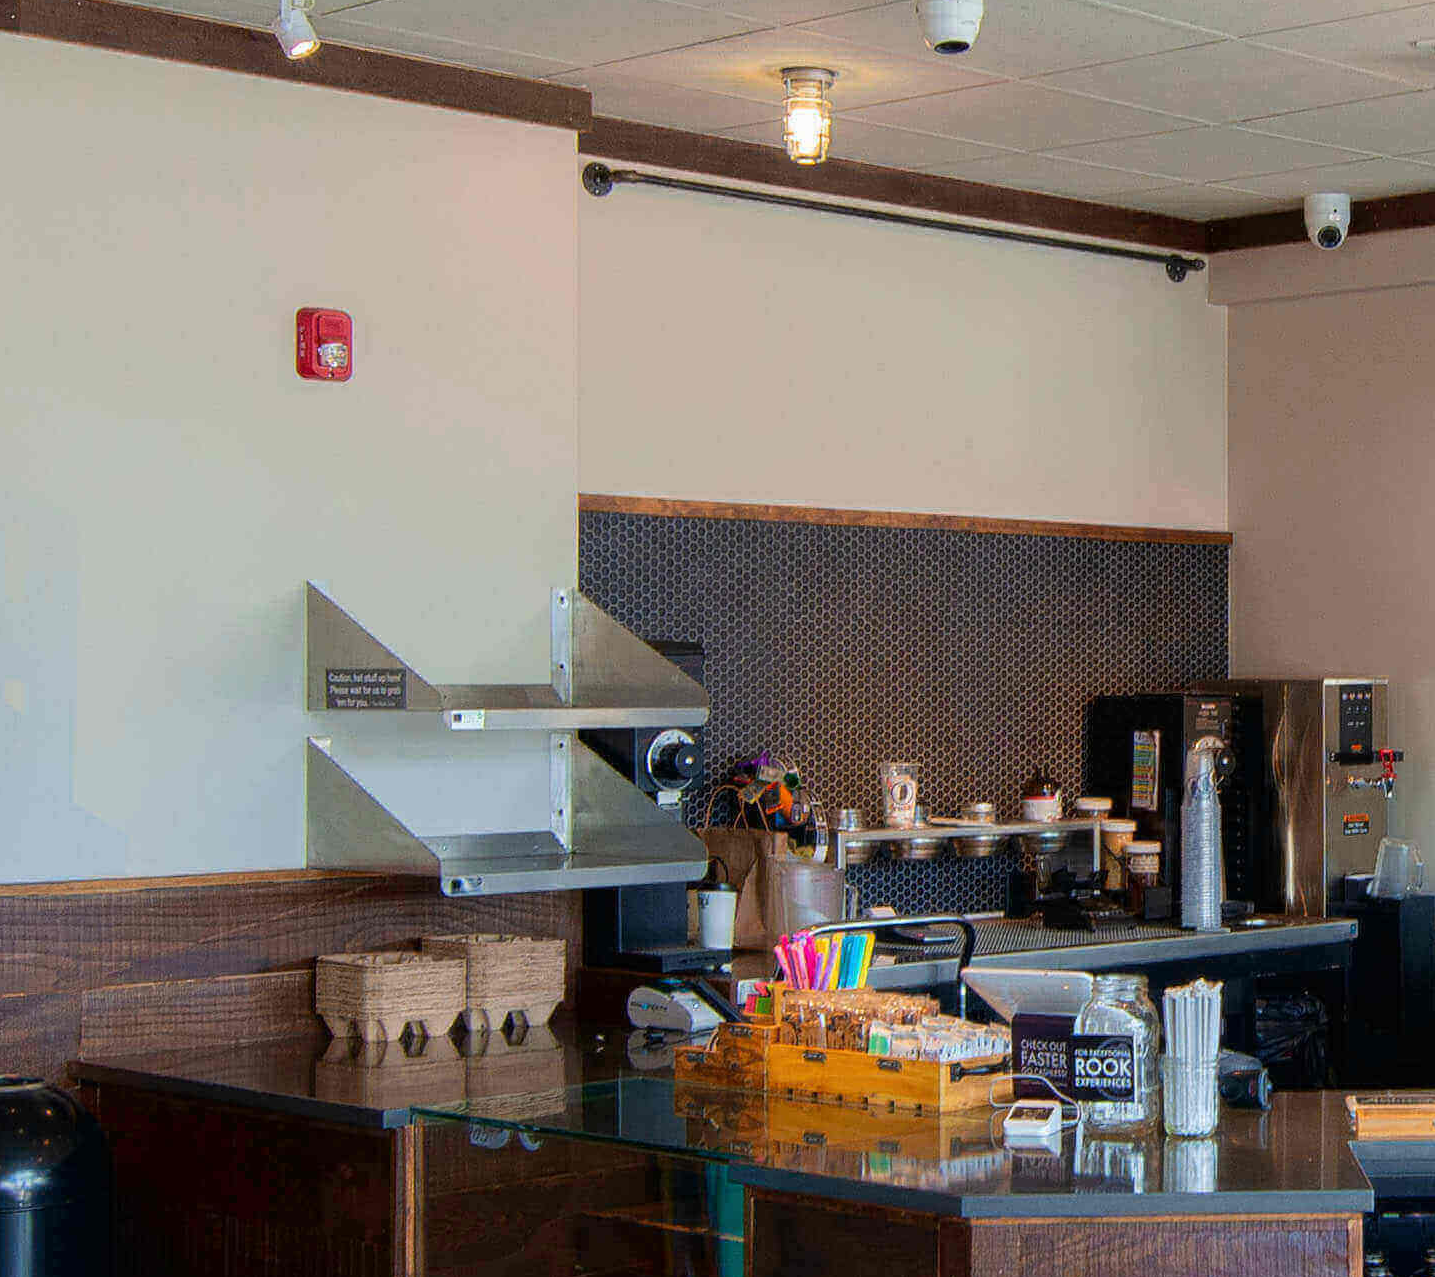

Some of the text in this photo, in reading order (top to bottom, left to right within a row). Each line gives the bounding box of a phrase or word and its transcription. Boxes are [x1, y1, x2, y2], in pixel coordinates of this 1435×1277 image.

[1020, 1039, 1067, 1053] CHECK OUT
[1020, 1051, 1068, 1069] FASTER
[1074, 1058, 1132, 1077] ROOK
[1075, 1077, 1132, 1089] EXPERIENCES
